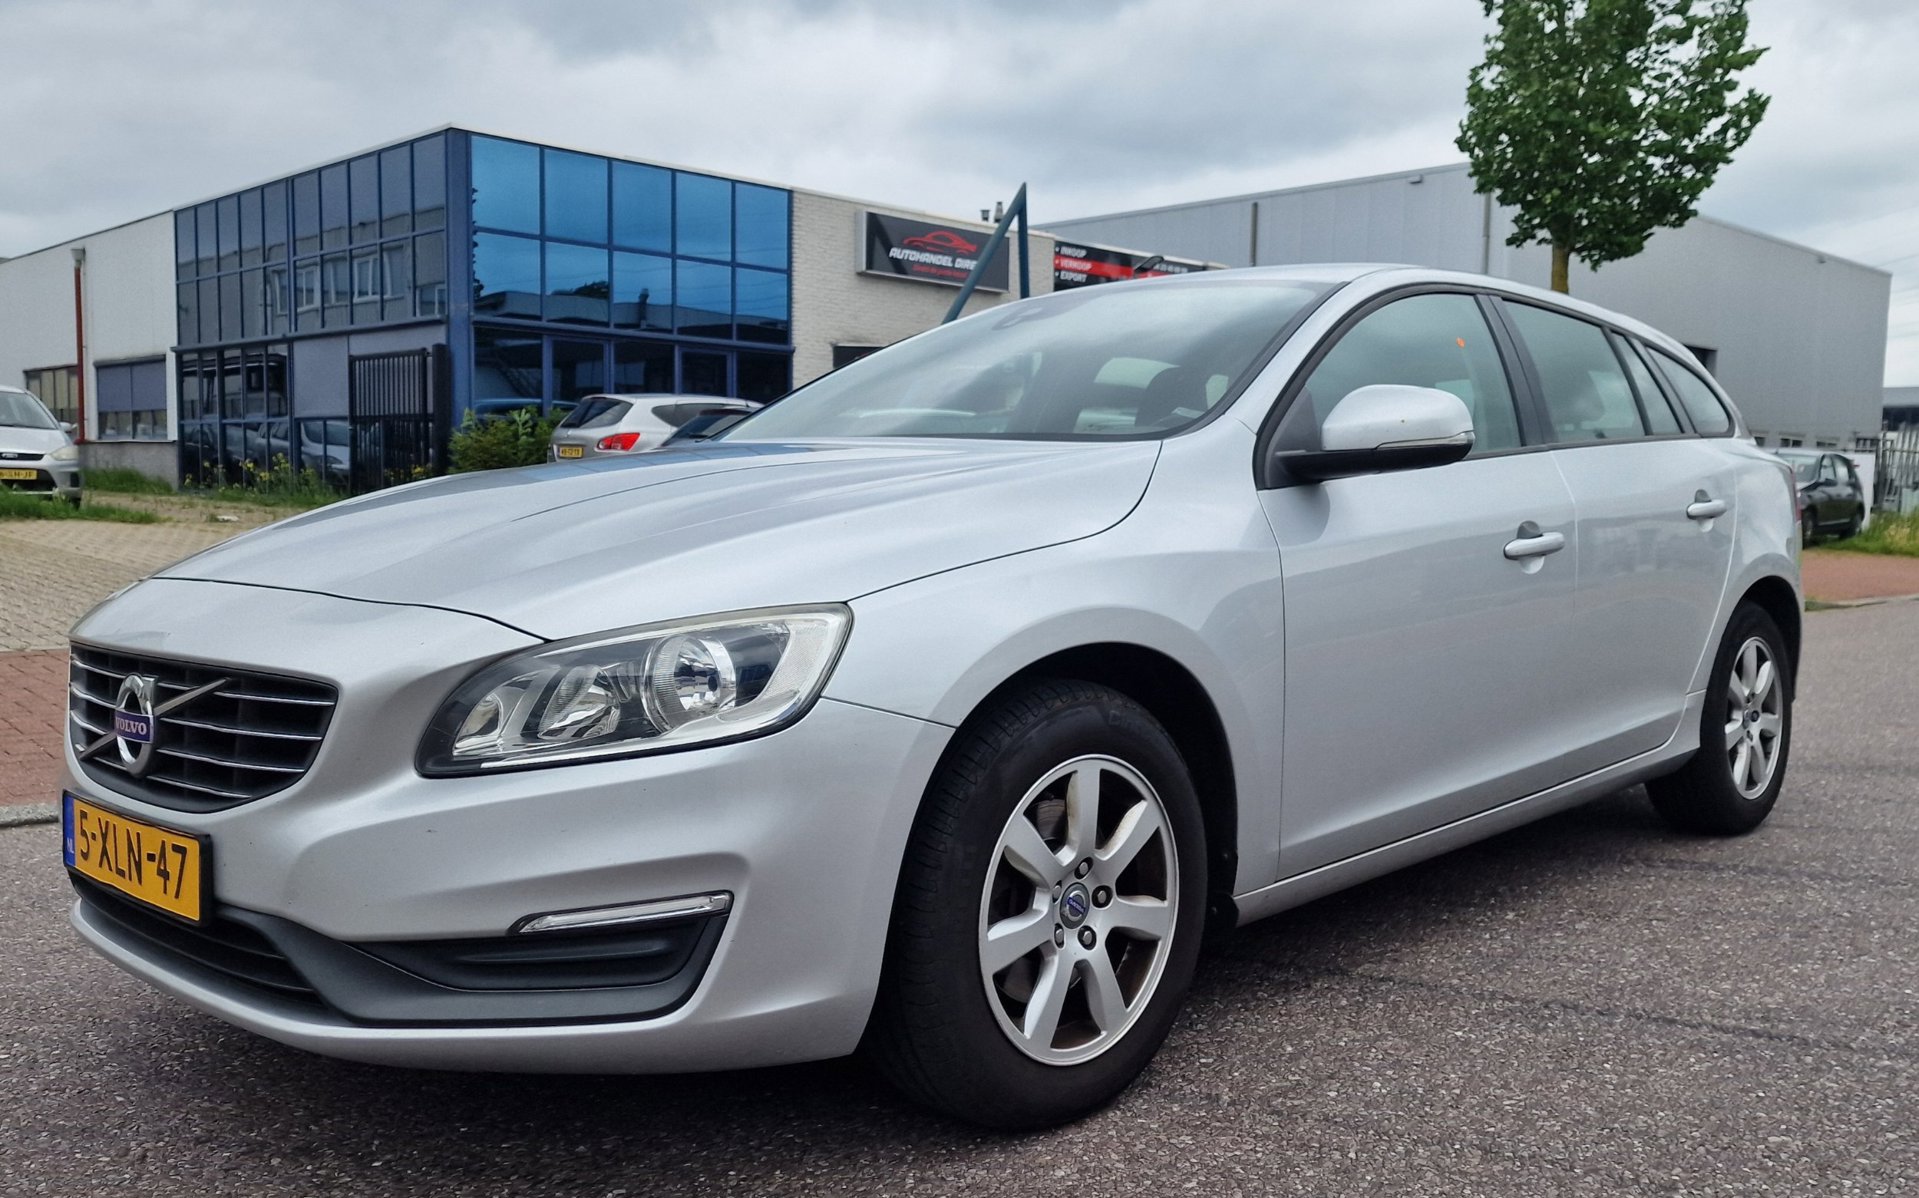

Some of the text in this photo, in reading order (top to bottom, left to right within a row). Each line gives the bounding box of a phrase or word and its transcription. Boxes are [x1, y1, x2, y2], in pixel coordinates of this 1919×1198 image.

[889, 247, 953, 266] AUTOHANDEL
[1060, 257, 1092, 270] VERKOOP
[1060, 270, 1088, 282] EXPORT
[115, 715, 147, 736] VOLVO
[66, 809, 188, 900] NL 5-XLN-47
